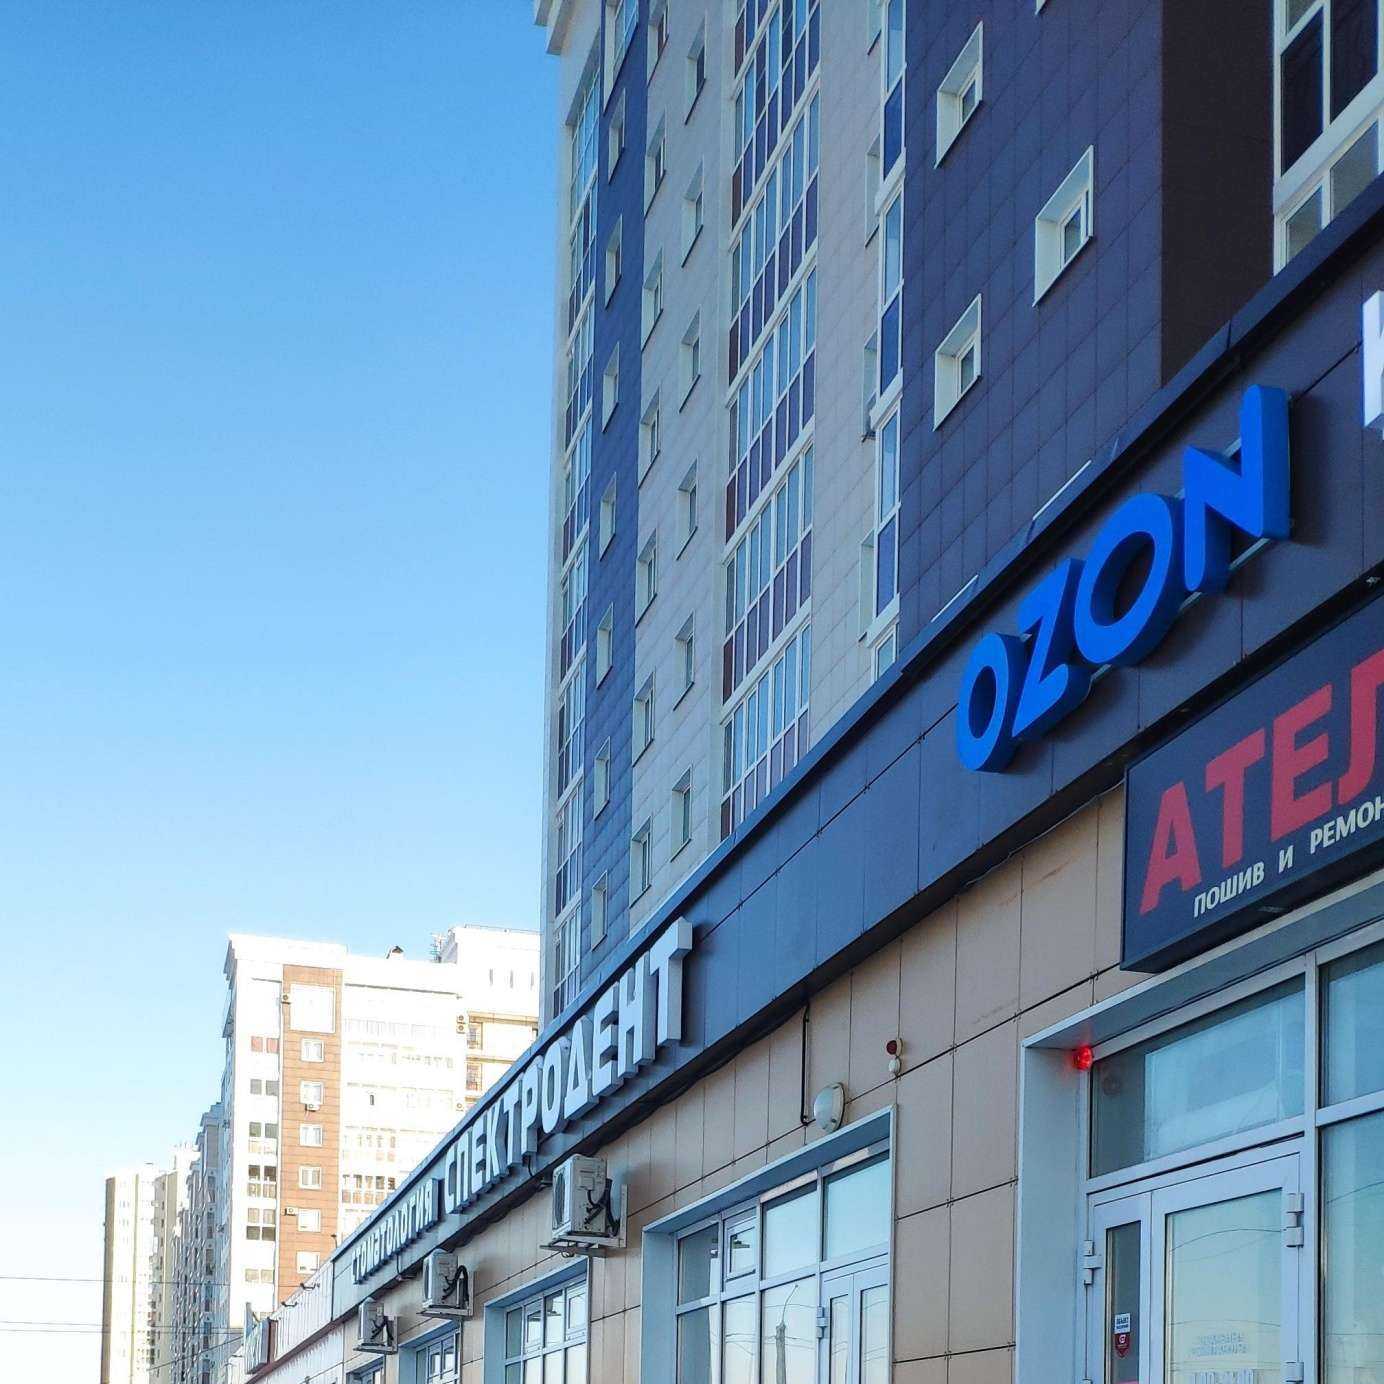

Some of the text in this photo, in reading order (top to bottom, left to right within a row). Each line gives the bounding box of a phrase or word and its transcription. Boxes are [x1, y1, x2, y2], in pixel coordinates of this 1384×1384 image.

[957, 385, 1290, 772] OZON
[1193, 862, 1265, 919] ПОШИВ
[1278, 845, 1294, 874] И
[444, 916, 693, 1214] СПЕКТРОДЕНТ
